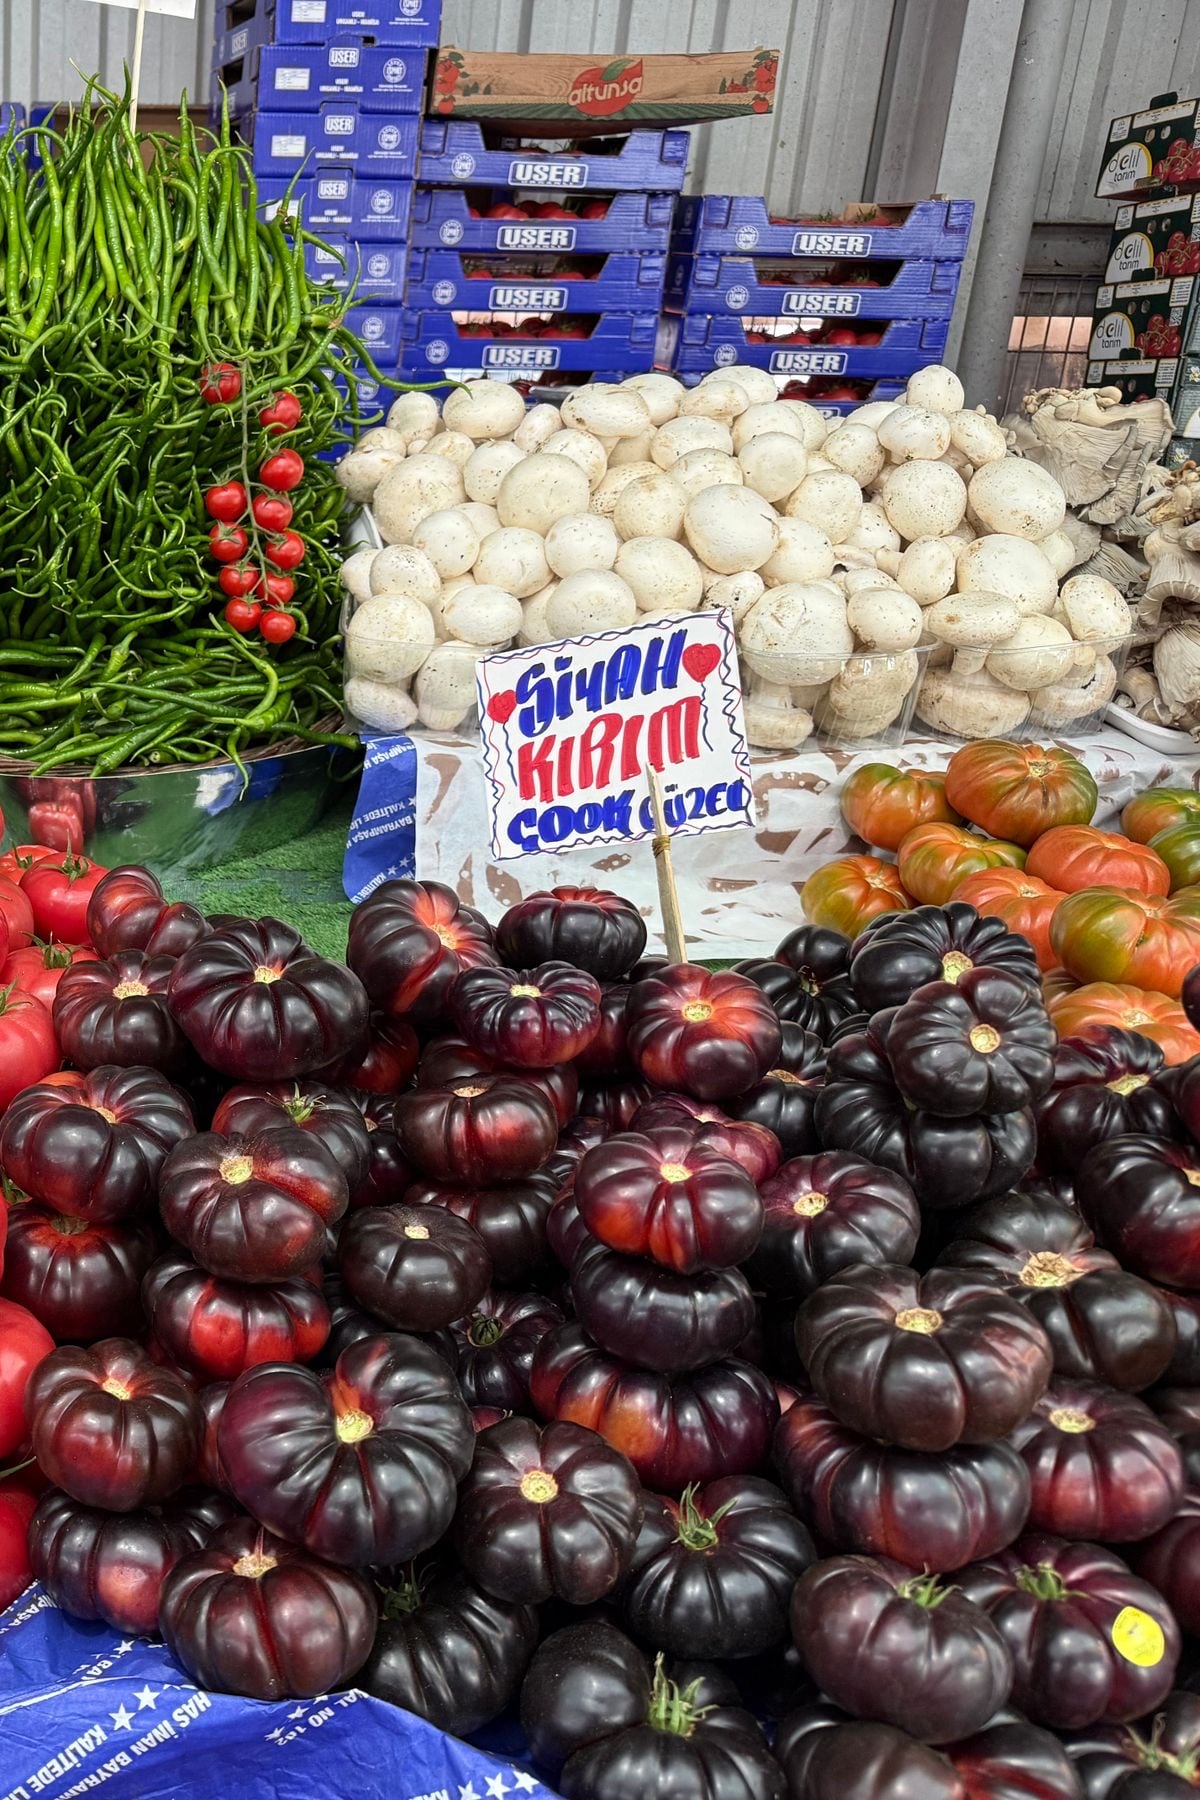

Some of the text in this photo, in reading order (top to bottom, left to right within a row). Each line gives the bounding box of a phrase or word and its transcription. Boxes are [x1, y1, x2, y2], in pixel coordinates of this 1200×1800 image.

[331, 51, 357, 63] USER
[568, 77, 643, 107] altunsa
[326, 118, 353, 131] USER
[515, 164, 580, 183] USER
[320, 182, 346, 196] USER
[503, 229, 568, 246] USER
[800, 235, 864, 252] USER
[496, 289, 560, 306] USER
[789, 295, 853, 312] USER
[488, 348, 552, 365] USER
[776, 353, 841, 370] USER
[9, 1594, 55, 1628] PAŞA
[172, 1690, 212, 1729] HAS
[307, 1707, 335, 1728] NO
[129, 1719, 179, 1756] İNAN
[26, 1723, 109, 1793] KALİTEDE
